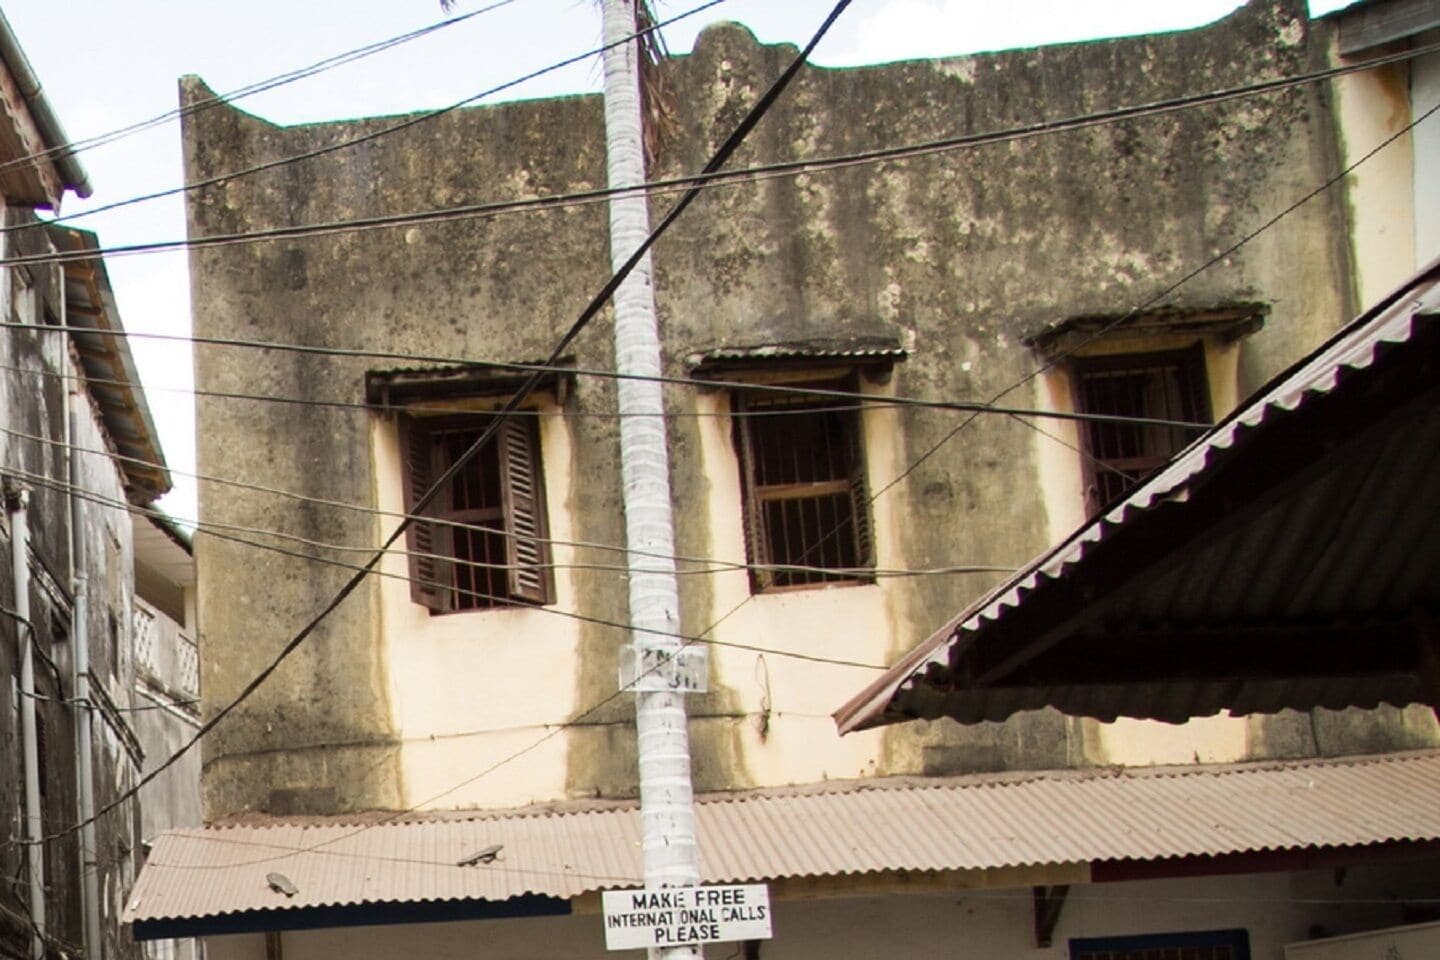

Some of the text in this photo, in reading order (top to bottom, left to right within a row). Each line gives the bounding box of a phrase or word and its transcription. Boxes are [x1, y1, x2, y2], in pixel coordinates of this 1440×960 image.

[632, 889, 745, 910] MAKE FREE
[607, 905, 766, 928] INTERNATONAL CALLS
[655, 925, 720, 943] PLEASE
